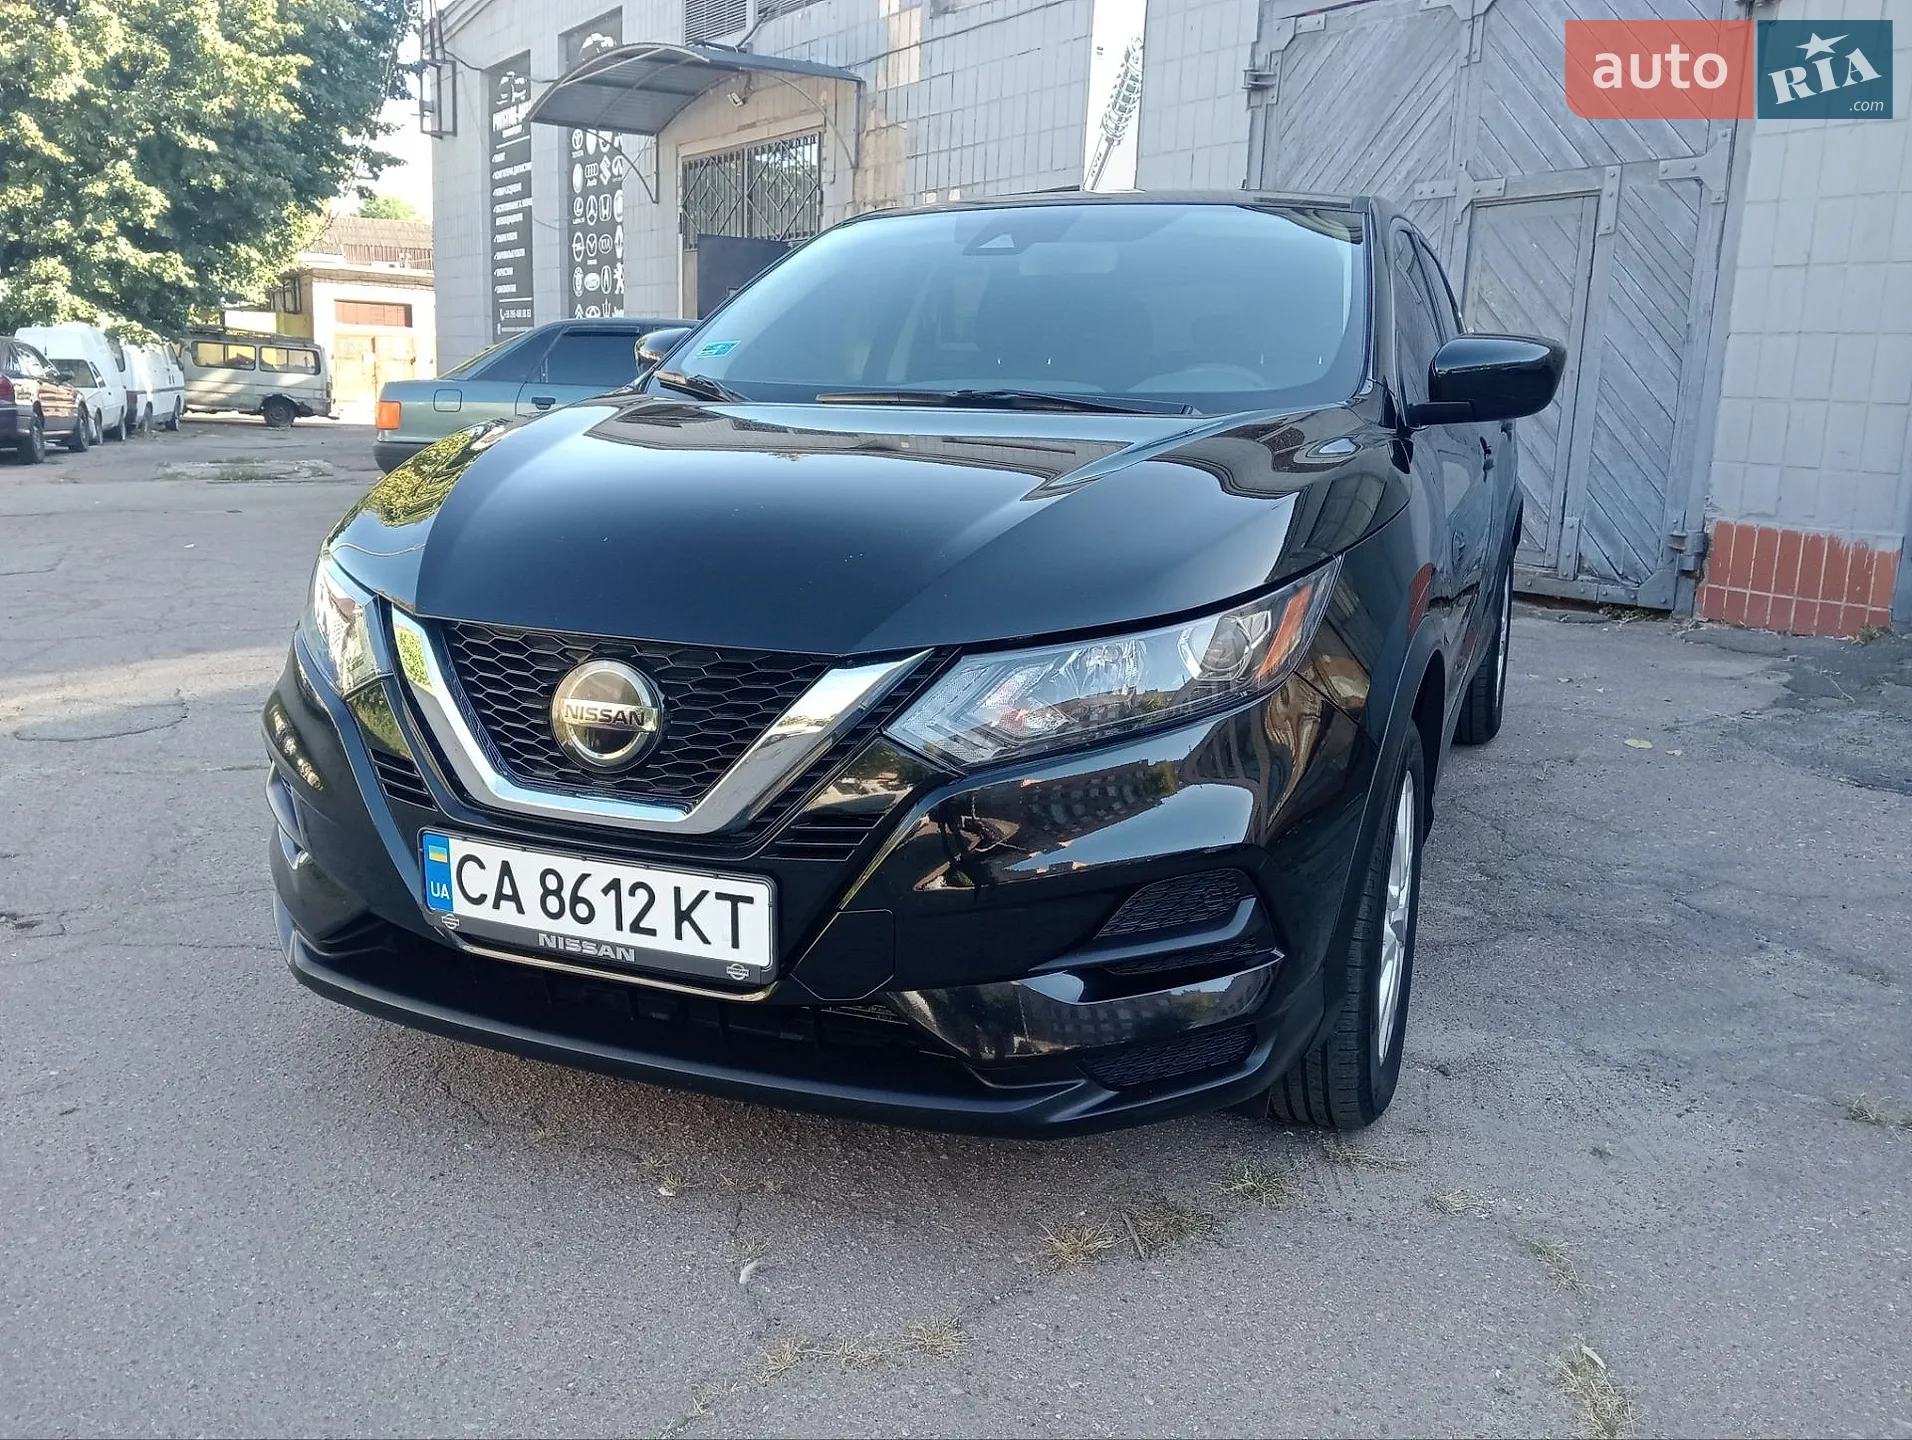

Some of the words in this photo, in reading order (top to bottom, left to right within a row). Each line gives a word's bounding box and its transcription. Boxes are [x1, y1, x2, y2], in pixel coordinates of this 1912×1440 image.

[564, 704, 645, 726] NISSAN
[430, 881, 450, 900] UA
[456, 853, 525, 915] CA
[539, 868, 657, 937] 8612
[674, 886, 755, 949] KT
[538, 933, 637, 962] NISSAN
